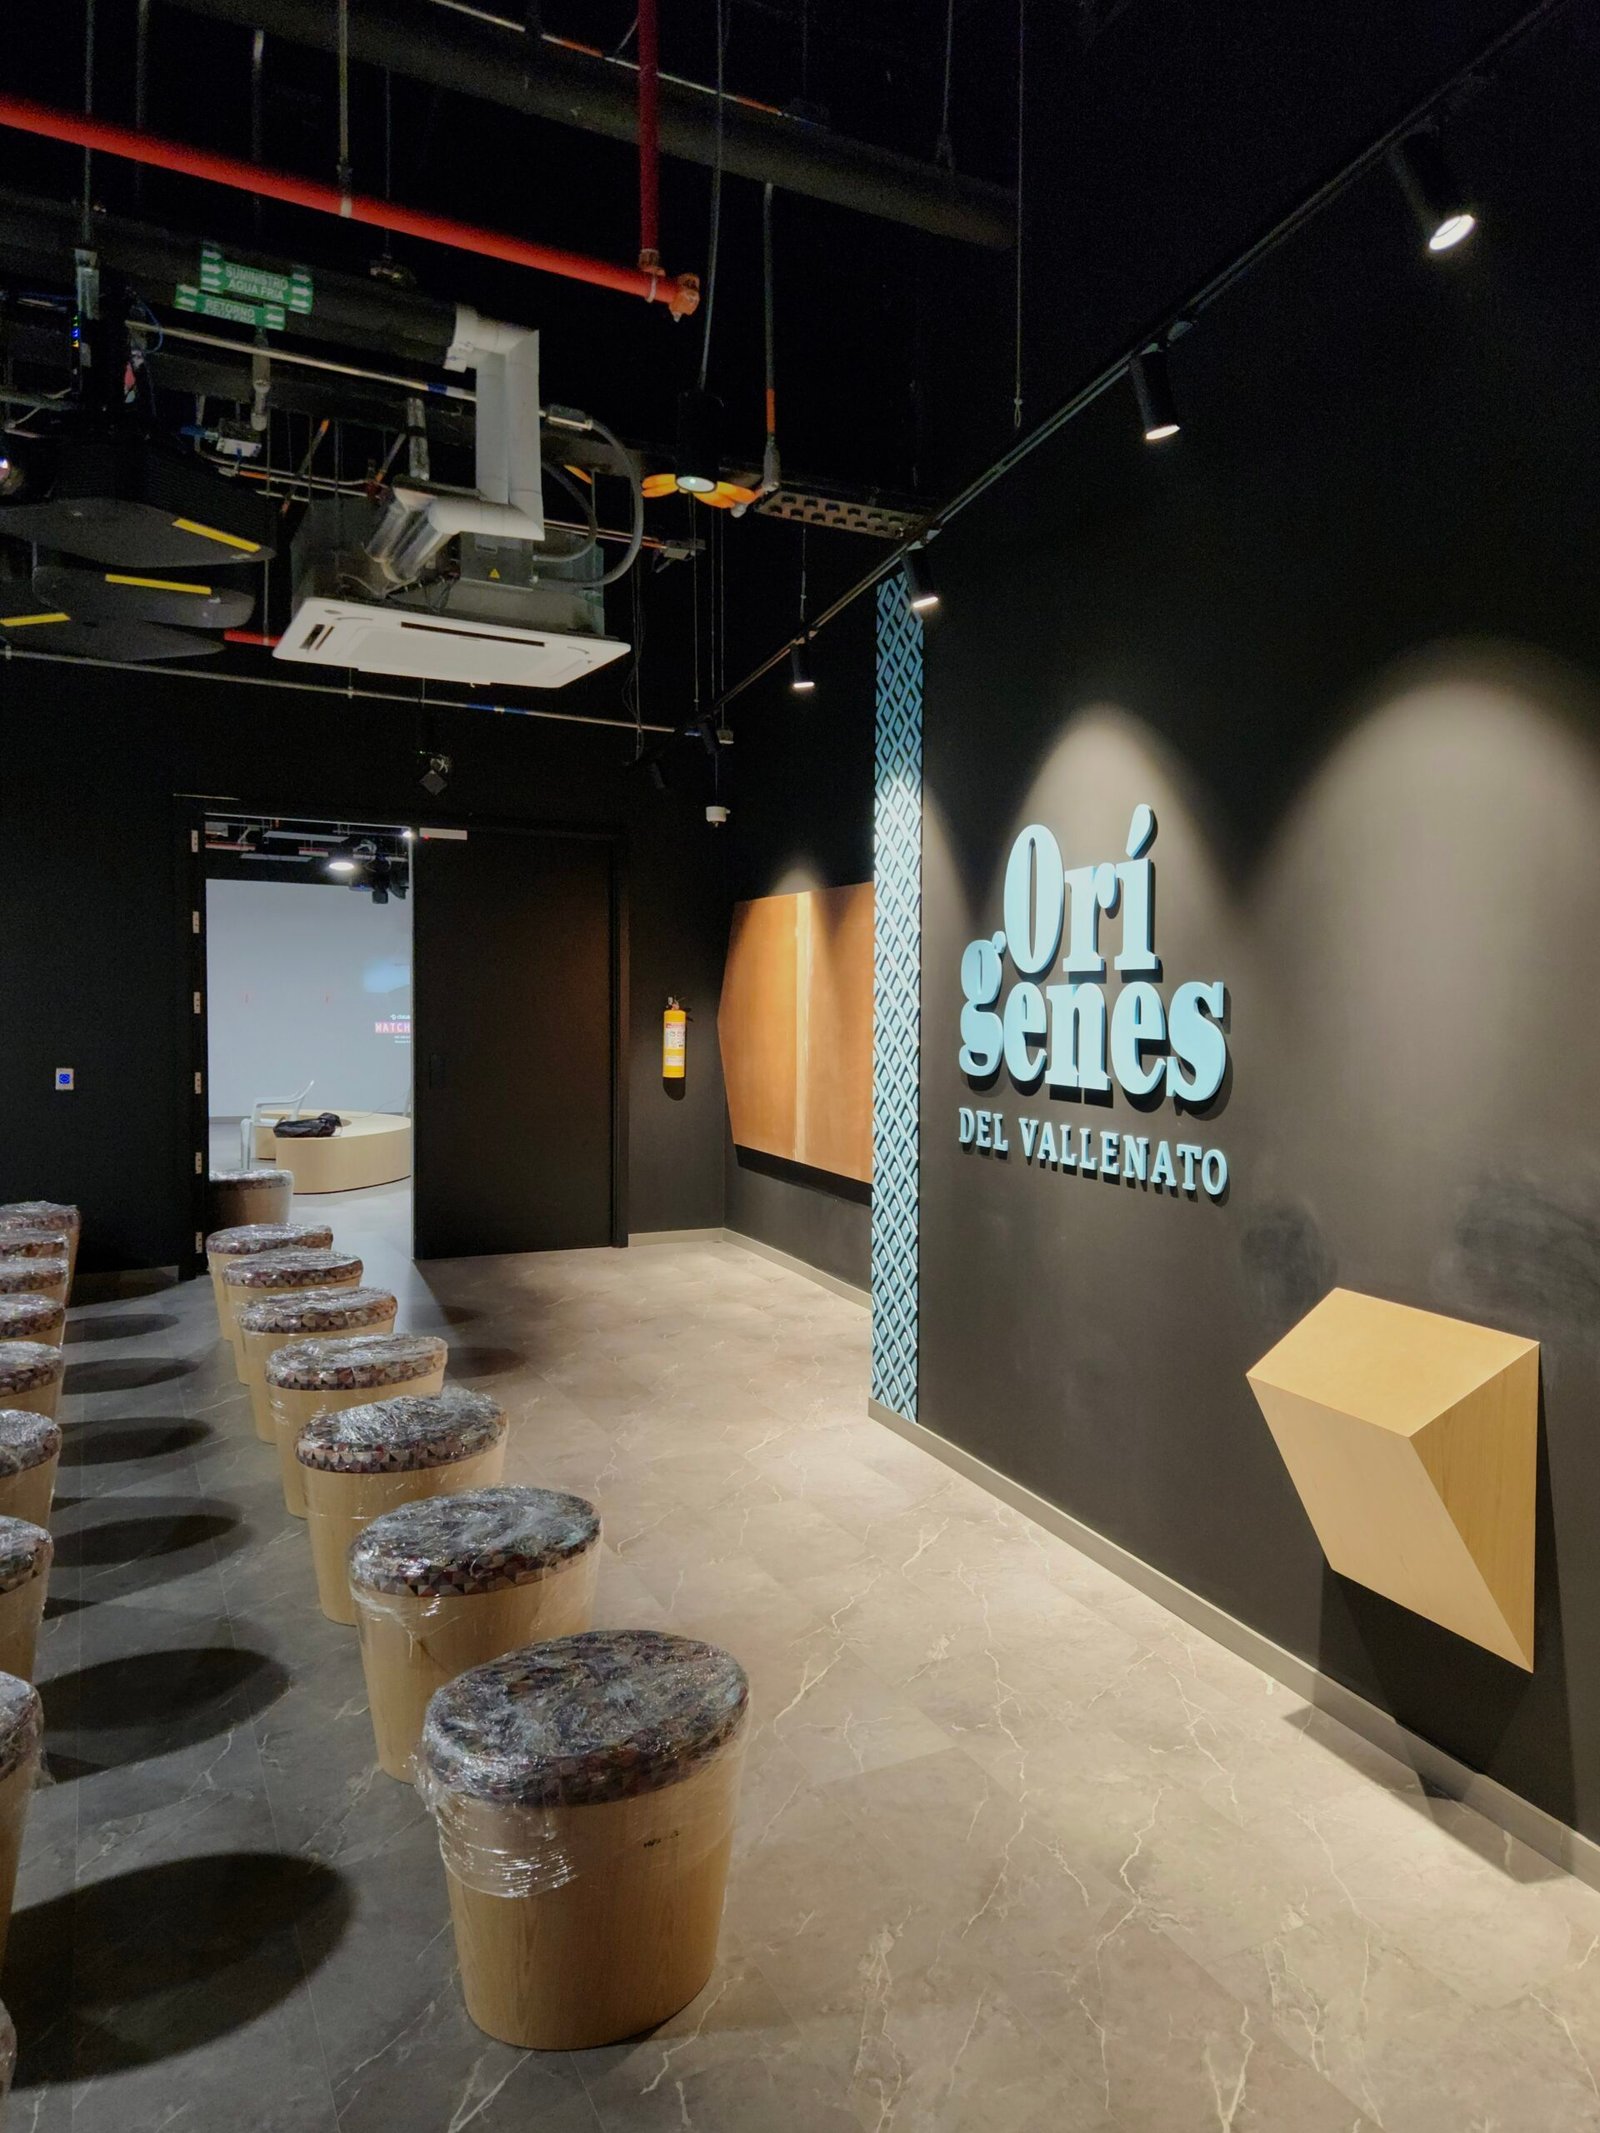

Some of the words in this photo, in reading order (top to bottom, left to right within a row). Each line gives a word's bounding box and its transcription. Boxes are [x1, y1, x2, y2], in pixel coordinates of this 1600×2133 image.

[226, 265, 289, 290] SUMINISTRO
[228, 279, 257, 294] AGUA
[260, 286, 284, 301] FRIA
[205, 299, 255, 318] RETORNO
[1004, 803, 1159, 974] Orí
[958, 930, 1226, 1102] genes
[958, 1107, 1009, 1152] DEL
[1018, 1117, 1229, 1195] VALLENATO
